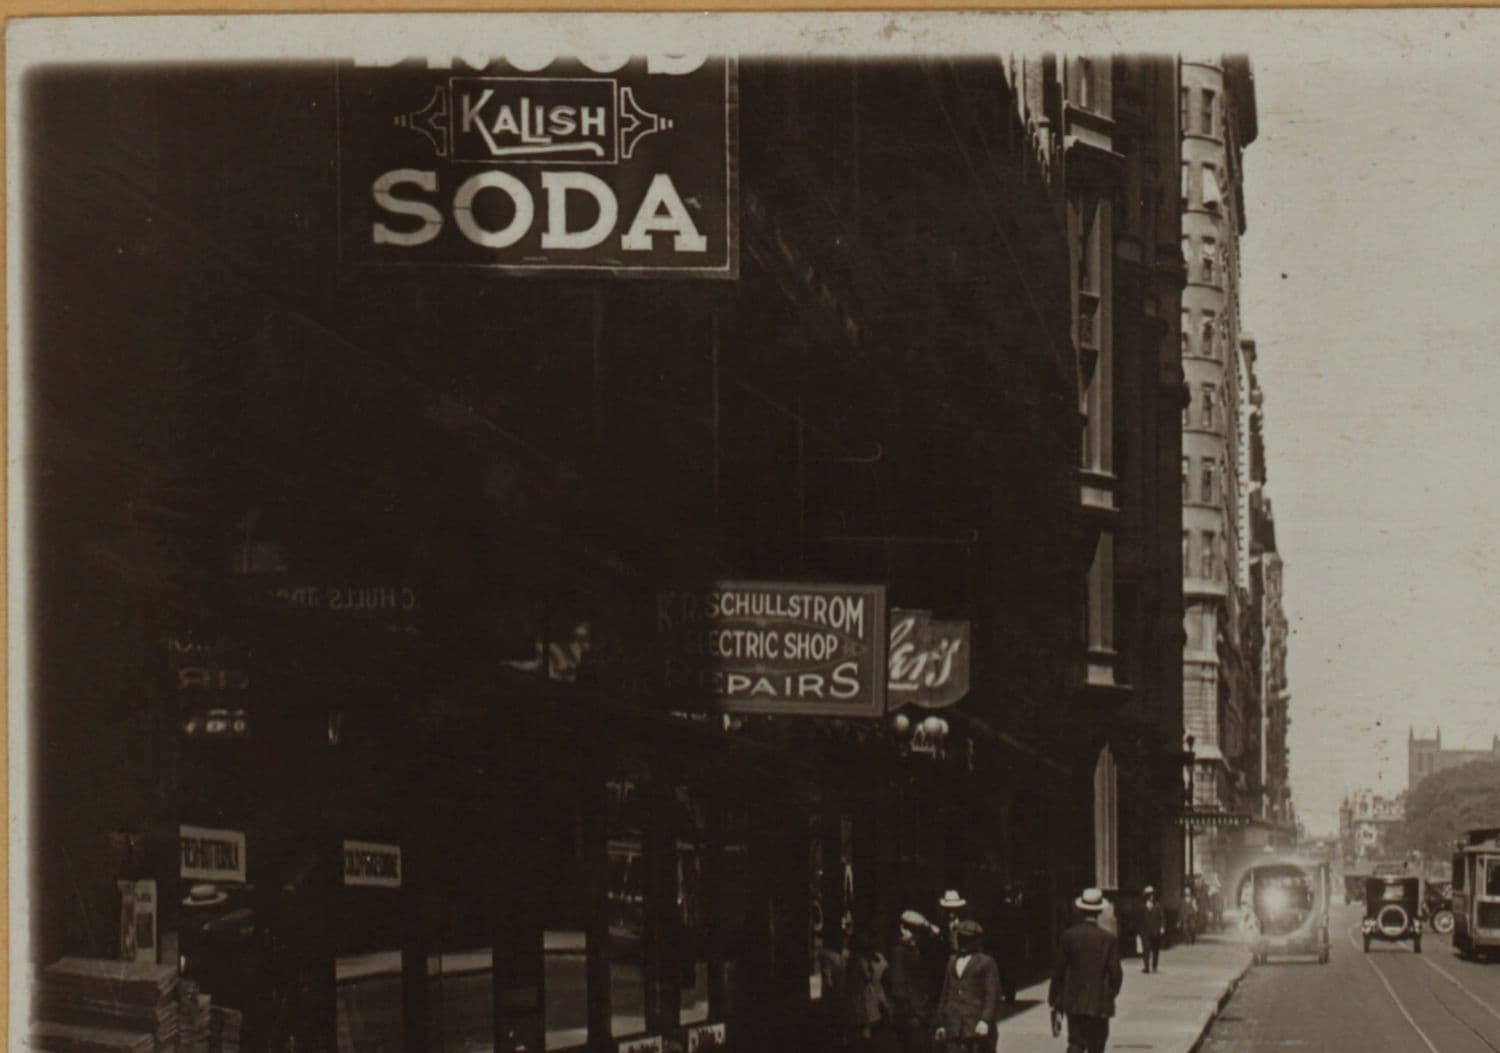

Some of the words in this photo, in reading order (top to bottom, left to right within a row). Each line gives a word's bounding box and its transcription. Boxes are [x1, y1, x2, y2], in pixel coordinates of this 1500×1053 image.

[372, 168, 708, 252] SODA
[708, 592, 863, 640] SCHULLSTROM
[783, 631, 838, 660] SHOP
